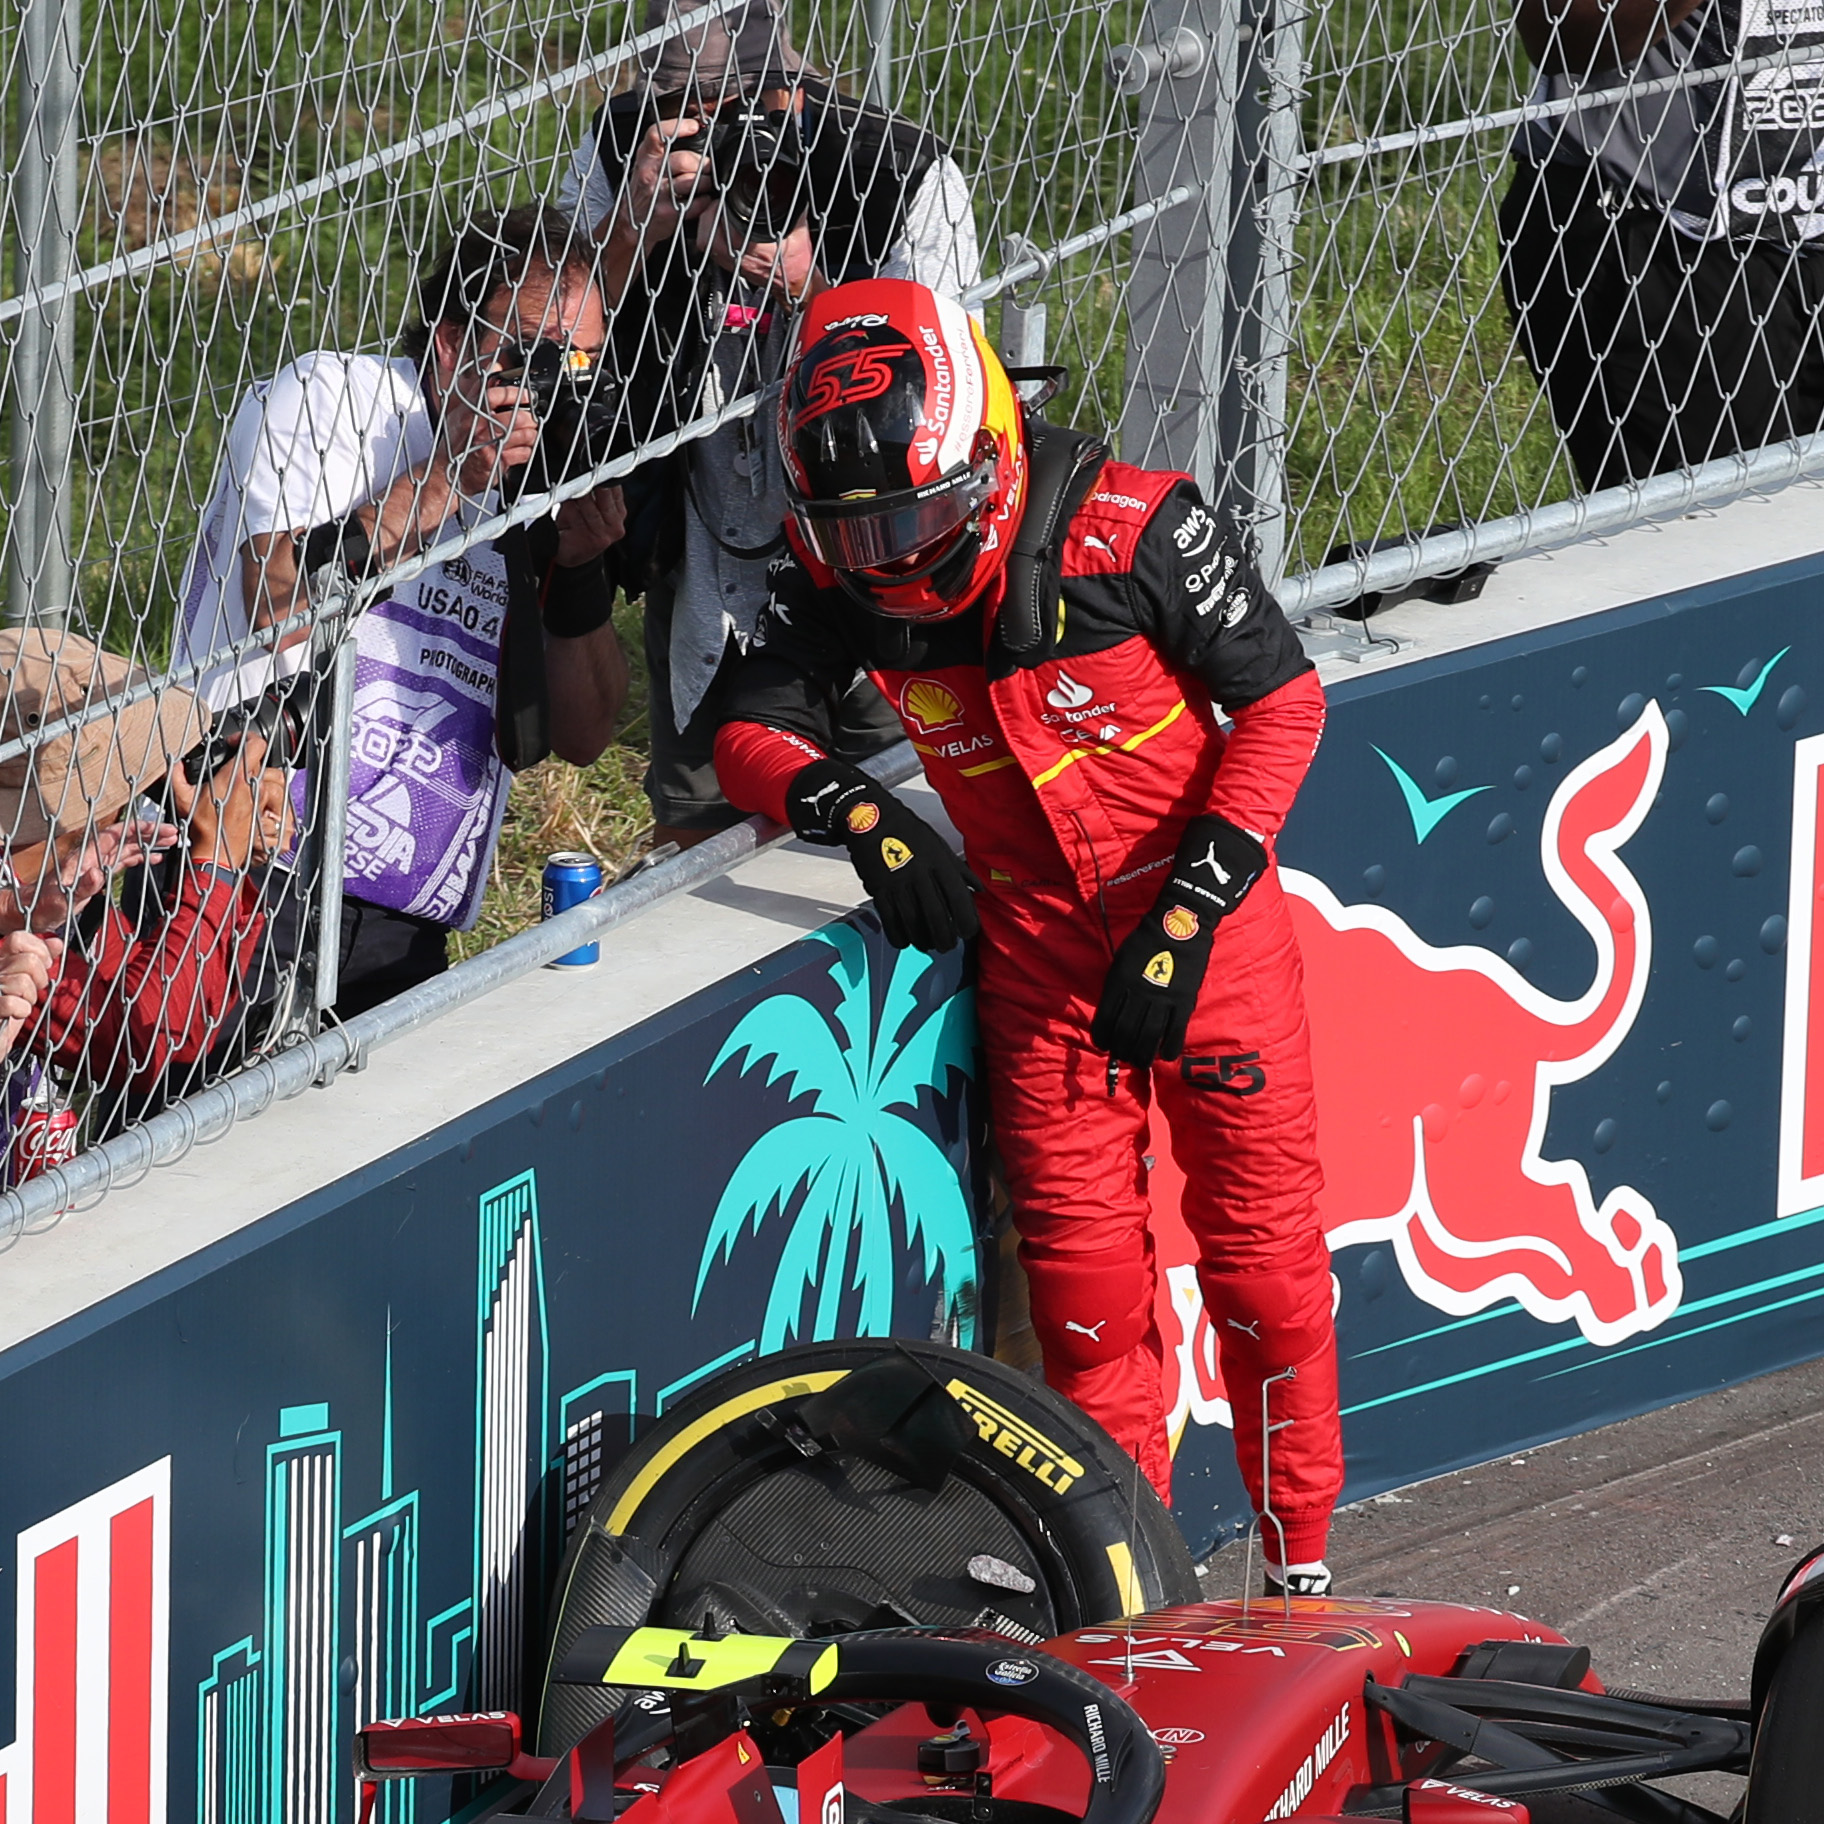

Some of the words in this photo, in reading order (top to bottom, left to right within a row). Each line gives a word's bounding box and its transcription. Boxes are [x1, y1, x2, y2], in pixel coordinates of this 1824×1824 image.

[794, 344, 912, 431] 55
[919, 326, 952, 436] Santander
[1174, 506, 1207, 549] aws
[934, 734, 994, 758] VELAS
[1180, 1050, 1267, 1096] 55
[416, 1710, 507, 1725] VELAS
[1084, 1703, 1108, 1754] RICHARD
[1314, 1701, 1351, 1780] MILLE
[1095, 1751, 1112, 1784] MILLE
[1446, 1786, 1518, 1809] VELAS
